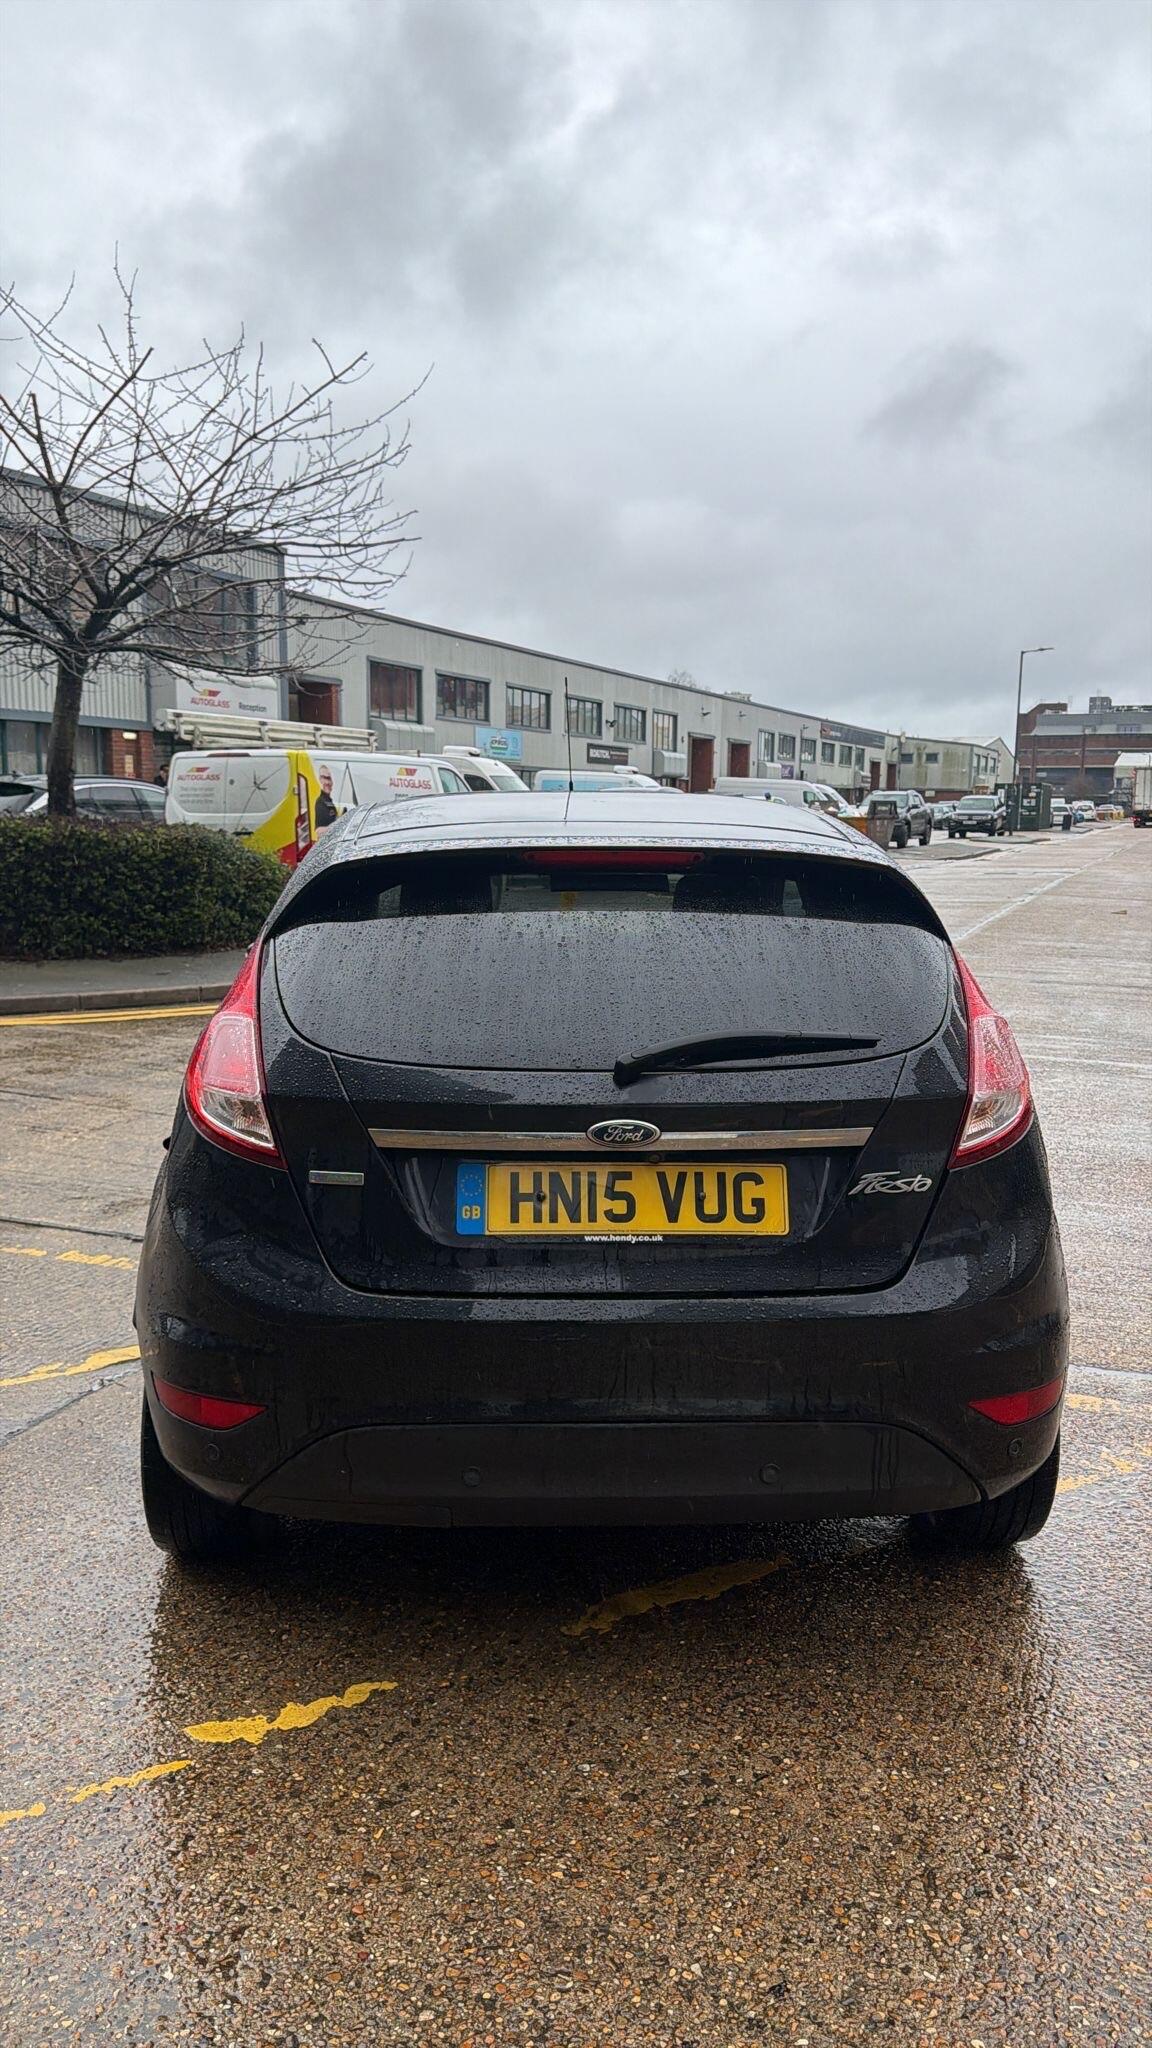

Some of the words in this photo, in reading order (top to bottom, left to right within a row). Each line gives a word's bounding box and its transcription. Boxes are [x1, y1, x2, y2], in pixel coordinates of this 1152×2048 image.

[190, 697, 230, 709] AUTOGLASS
[238, 702, 267, 713] Reception
[389, 778, 431, 790] AUTOGLASS
[604, 1125, 644, 1141] Ford
[848, 1171, 932, 1195] Fiesta
[510, 1171, 636, 1224] HN15
[656, 1171, 766, 1224] VUG
[463, 1205, 480, 1219] GB
[584, 1234, 663, 1244] www.hendy.co.uk
